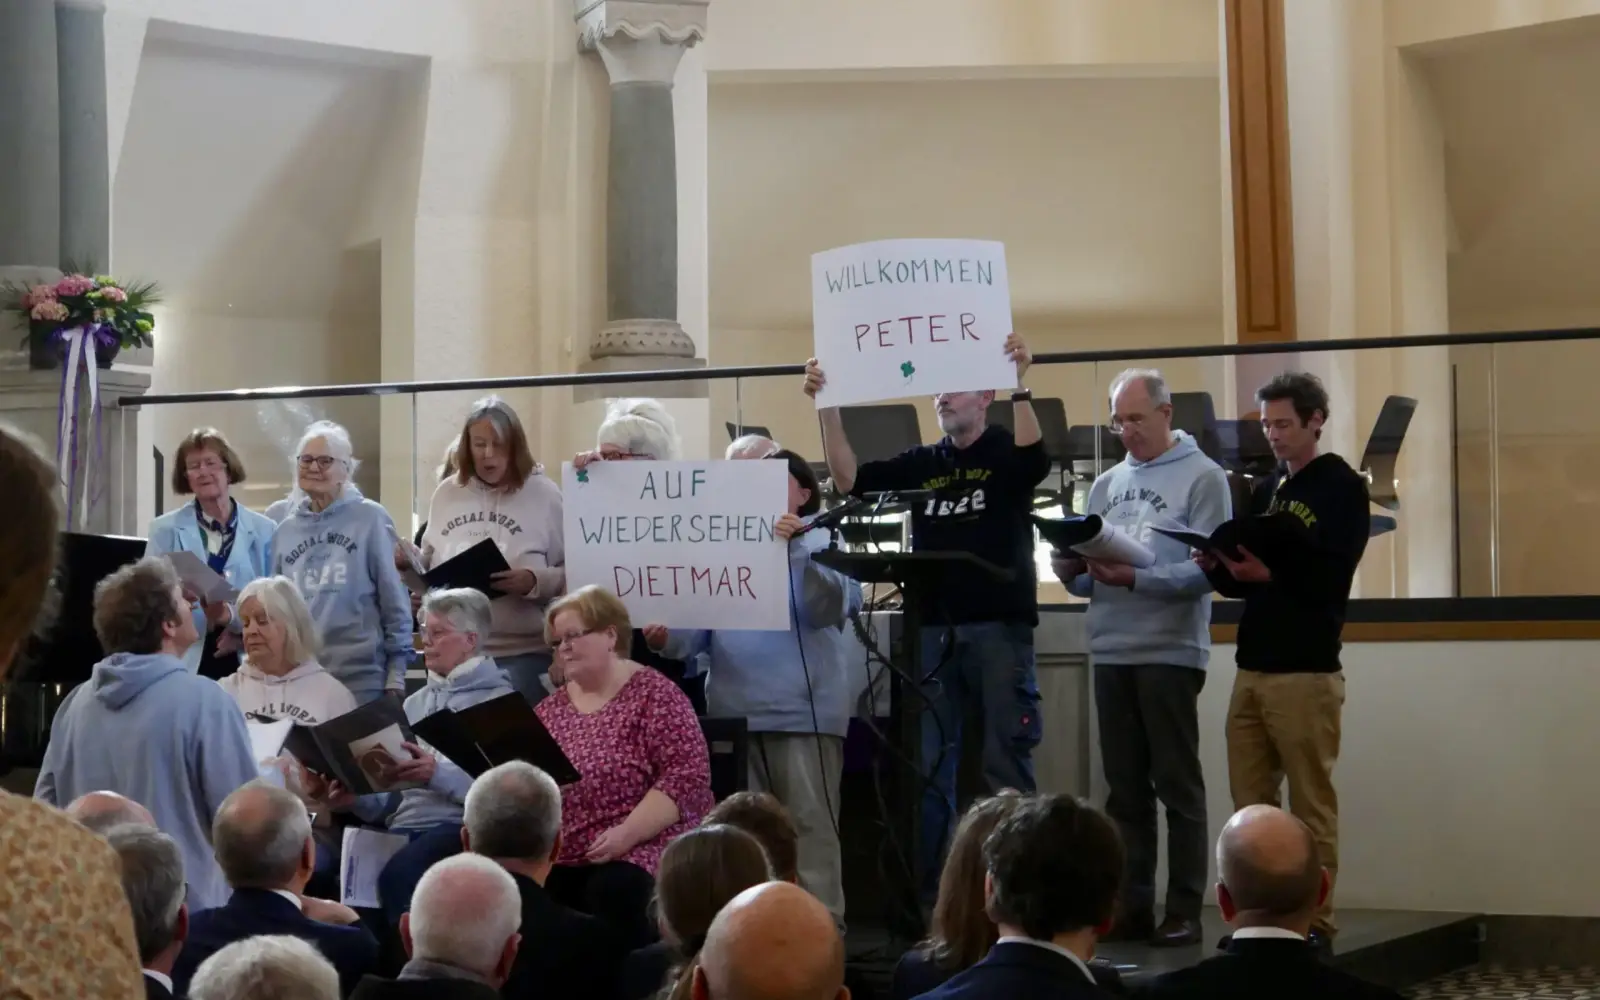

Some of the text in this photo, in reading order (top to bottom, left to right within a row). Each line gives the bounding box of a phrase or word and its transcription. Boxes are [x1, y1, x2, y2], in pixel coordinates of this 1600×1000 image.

[825, 258, 994, 294] WILLKOMMEN
[854, 312, 981, 353] PETER
[639, 469, 707, 500] AUF
[440, 511, 523, 537] SOCIAL WORK
[579, 514, 776, 545] WIEDERSEHEN
[284, 531, 358, 565] SOCIAL WORK
[613, 565, 757, 600] DIETMAR
